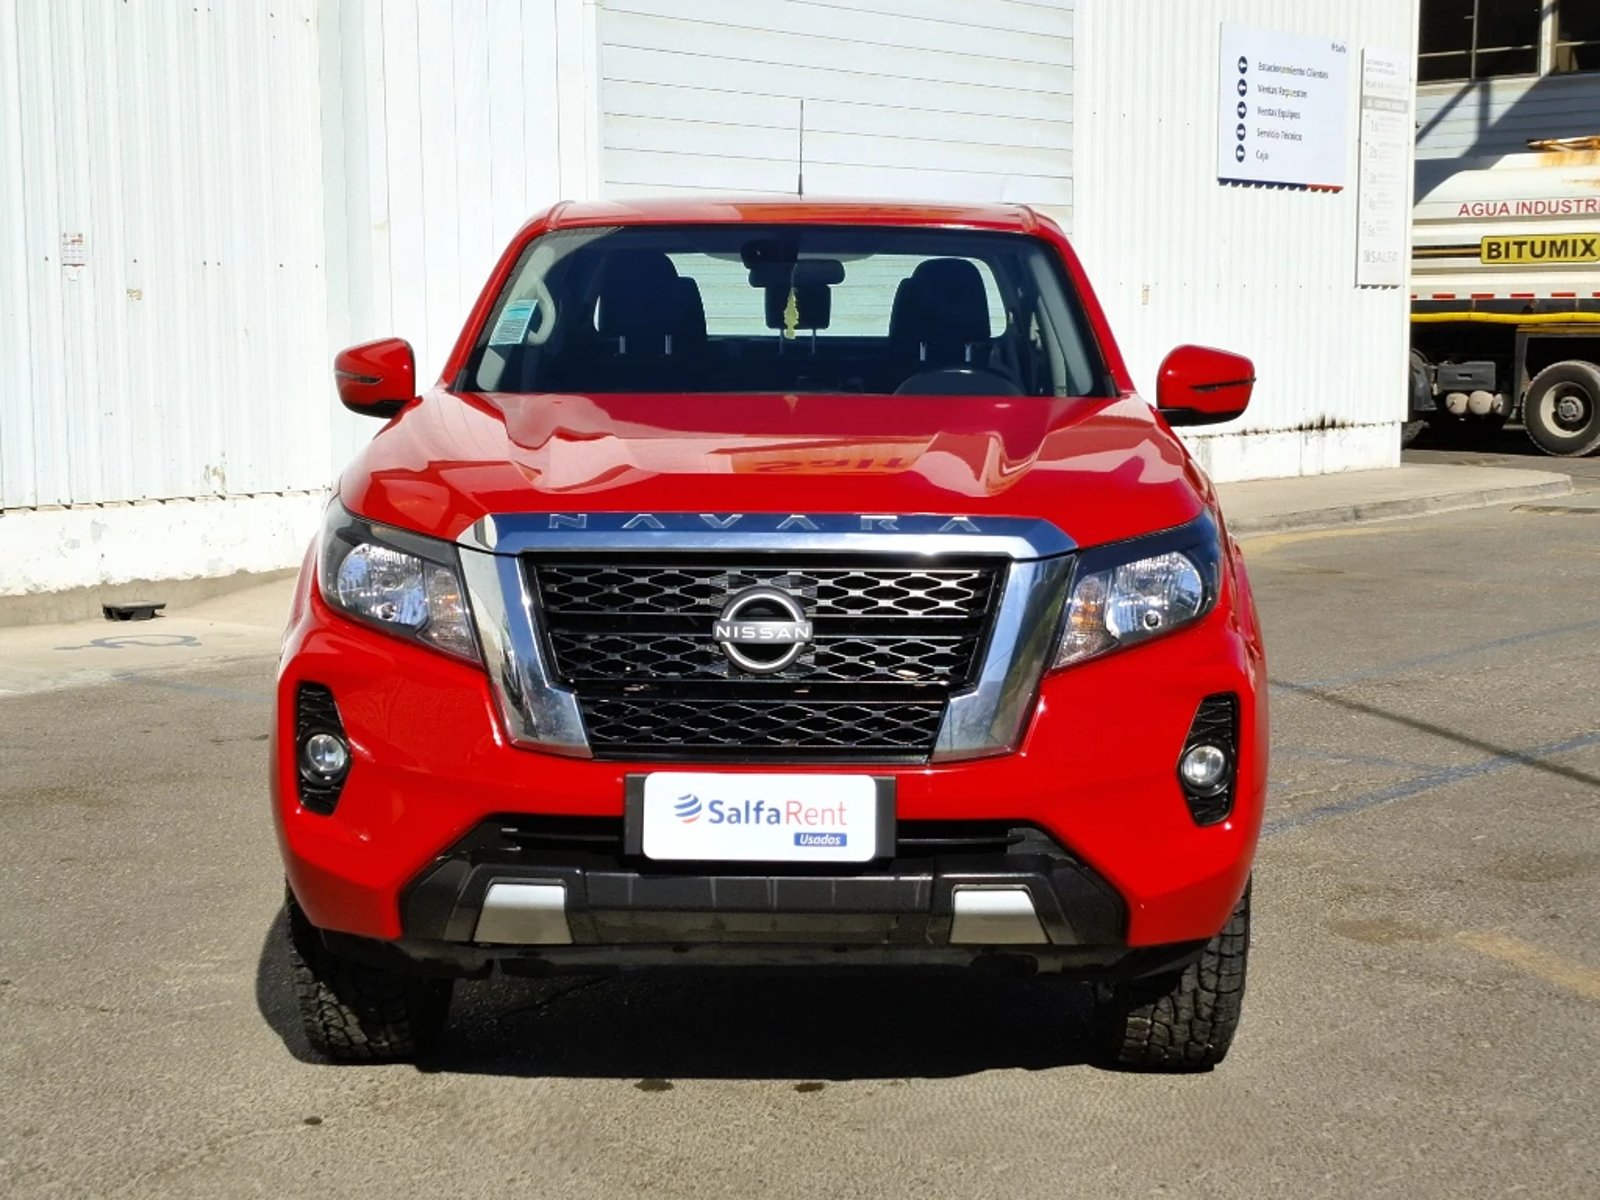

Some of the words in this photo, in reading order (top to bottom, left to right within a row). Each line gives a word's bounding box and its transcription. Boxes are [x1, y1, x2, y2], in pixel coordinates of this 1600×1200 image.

[1257, 84, 1277, 95] Ventas
[1256, 127, 1280, 139] Servicio
[1256, 149, 1269, 162] Caja
[1458, 202, 1510, 216] AGUA
[1487, 238, 1597, 260] BITUMIX
[548, 513, 982, 532] NAVARA
[715, 624, 811, 641] NISSAN
[708, 800, 848, 826] SalfaRent
[799, 834, 841, 846] Usados
